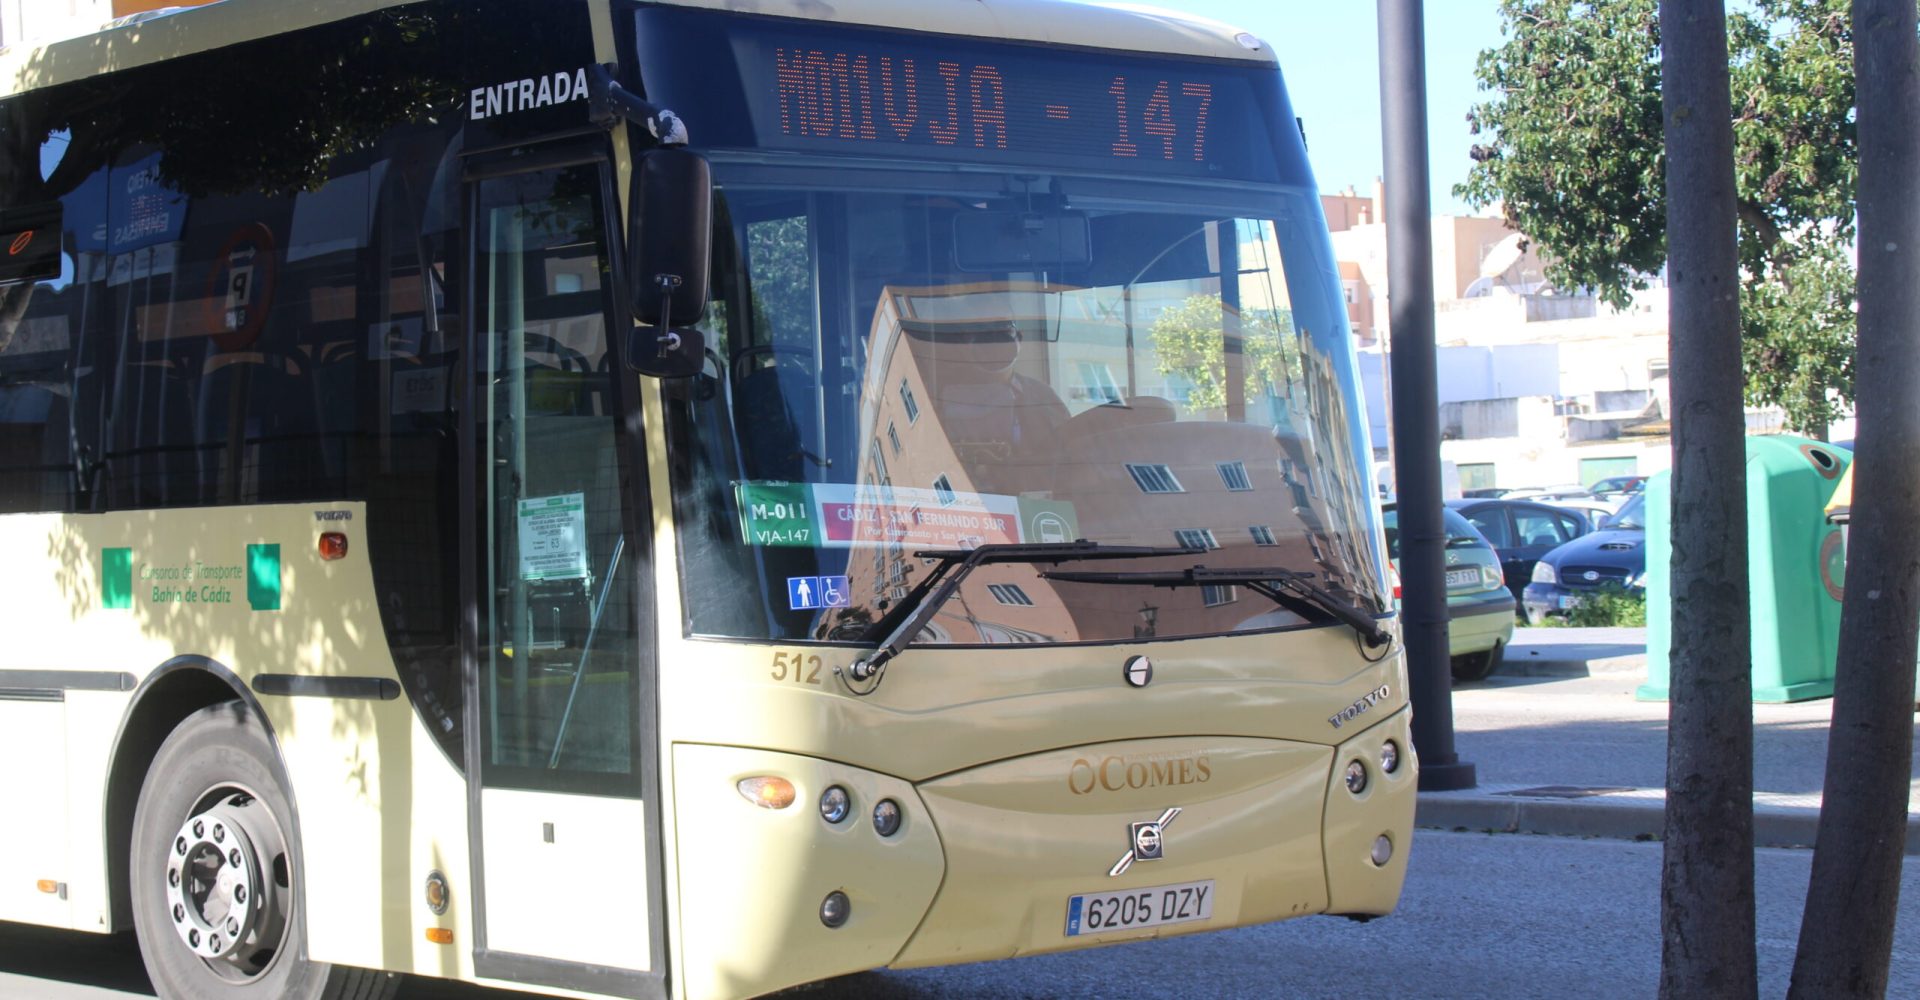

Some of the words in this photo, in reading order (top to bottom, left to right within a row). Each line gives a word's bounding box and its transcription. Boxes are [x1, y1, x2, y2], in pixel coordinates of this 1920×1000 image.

[470, 67, 589, 121] ENTRADA
[1108, 77, 1212, 161] 147
[751, 503, 807, 521] M-011
[837, 503, 877, 522] CÁDIZ
[889, 510, 914, 524] SAN
[917, 511, 980, 530] FERNANDO
[983, 517, 1007, 531] SUR
[756, 529, 810, 546] VJA-147
[140, 563, 183, 580] Consorcio
[184, 563, 193, 580] de
[195, 562, 243, 582] Transporte
[152, 585, 182, 603] Bahía
[185, 585, 198, 602] de
[201, 584, 232, 603] Cádiz
[771, 651, 823, 685] 512
[1327, 684, 1390, 729] VOLVO
[1087, 892, 1152, 929] 6205
[1160, 885, 1209, 921] DZY
